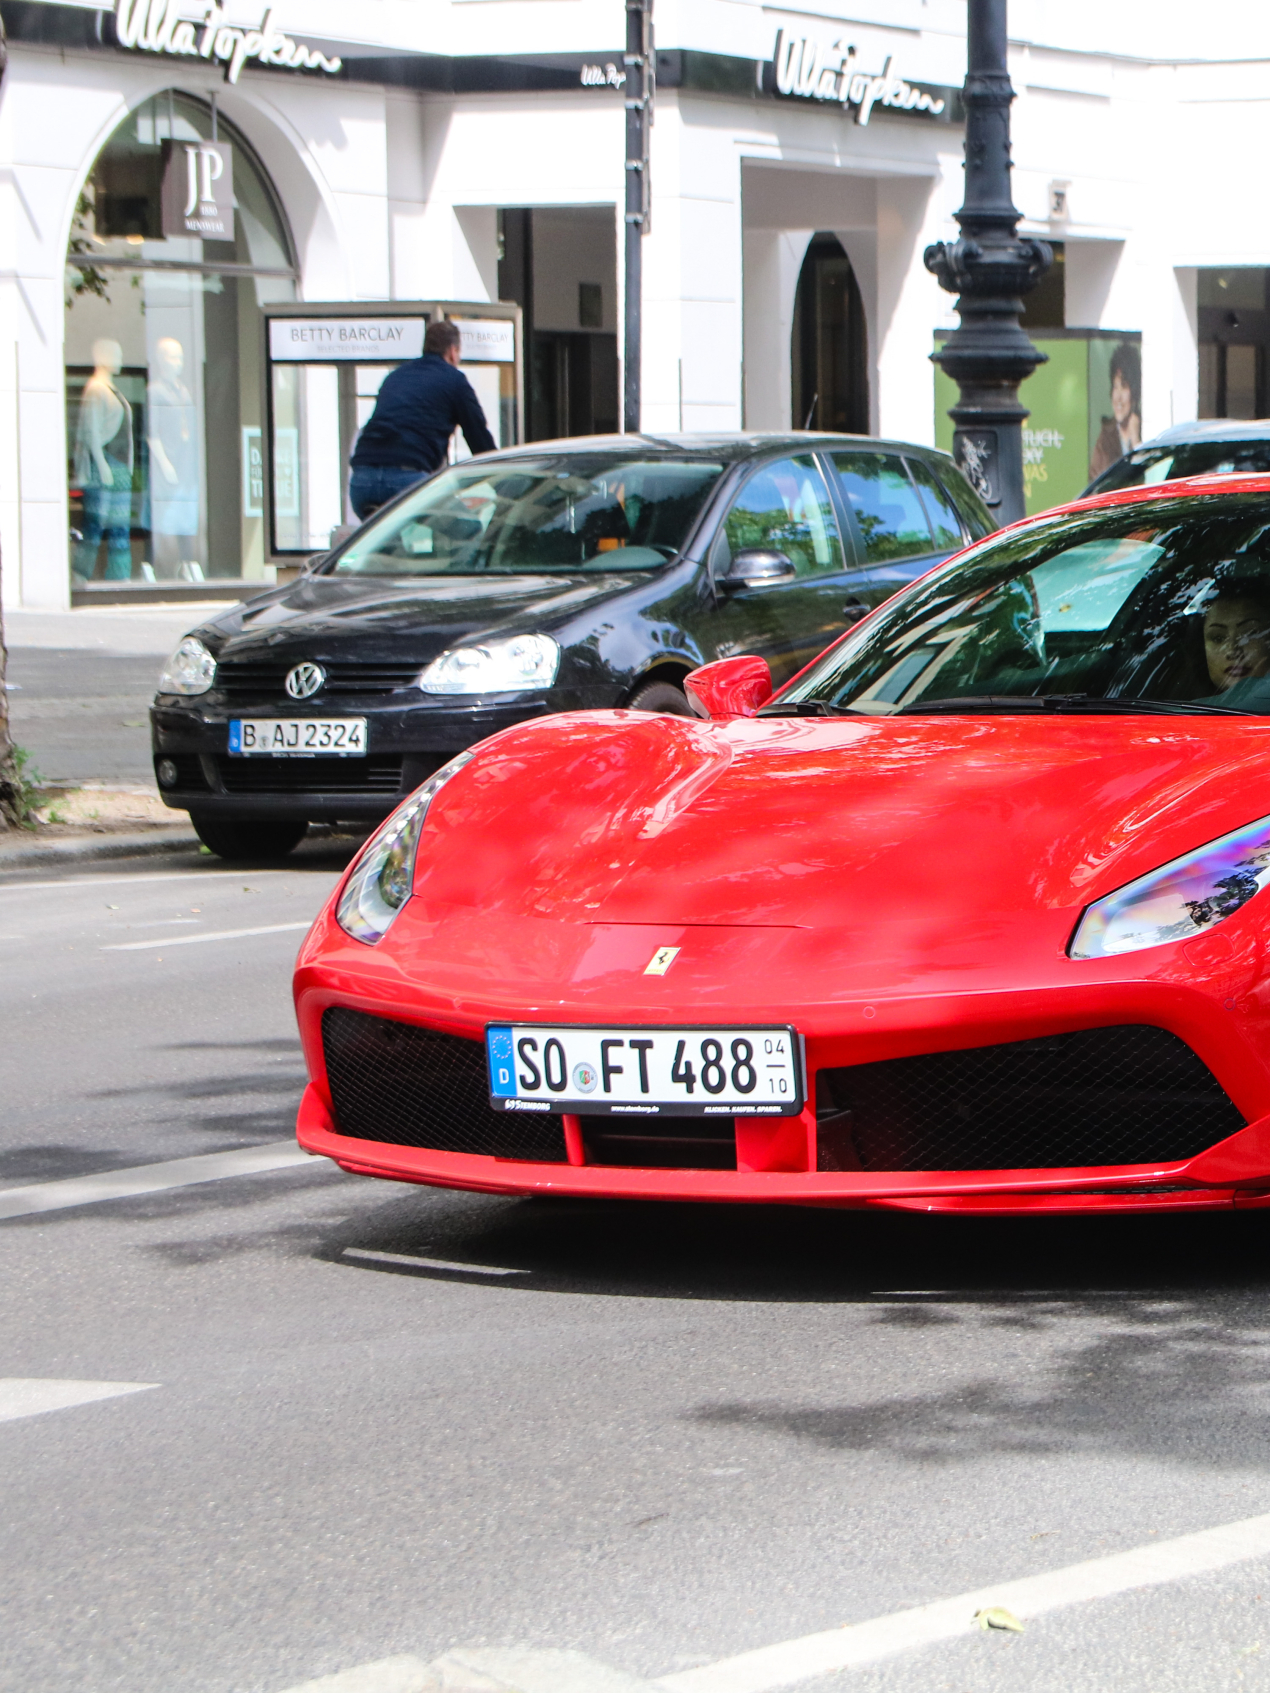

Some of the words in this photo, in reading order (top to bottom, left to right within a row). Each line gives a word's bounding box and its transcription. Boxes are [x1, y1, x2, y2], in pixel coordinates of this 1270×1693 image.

[776, 23, 839, 100] Ulla
[833, 38, 945, 127] Popken
[183, 145, 224, 217] JP
[184, 219, 226, 233] MENSWEAR
[290, 327, 335, 342] BETTY
[339, 326, 404, 342] BARCLAY
[476, 332, 510, 344] BARCLAY
[243, 724, 257, 748] B
[272, 724, 299, 748] AJ
[305, 724, 361, 748] 2324
[764, 1038, 785, 1054] 04
[498, 1068, 509, 1084] D
[517, 1037, 568, 1092] SO
[601, 1038, 654, 1093] FT
[671, 1038, 757, 1094] 488
[768, 1077, 788, 1094] 10
